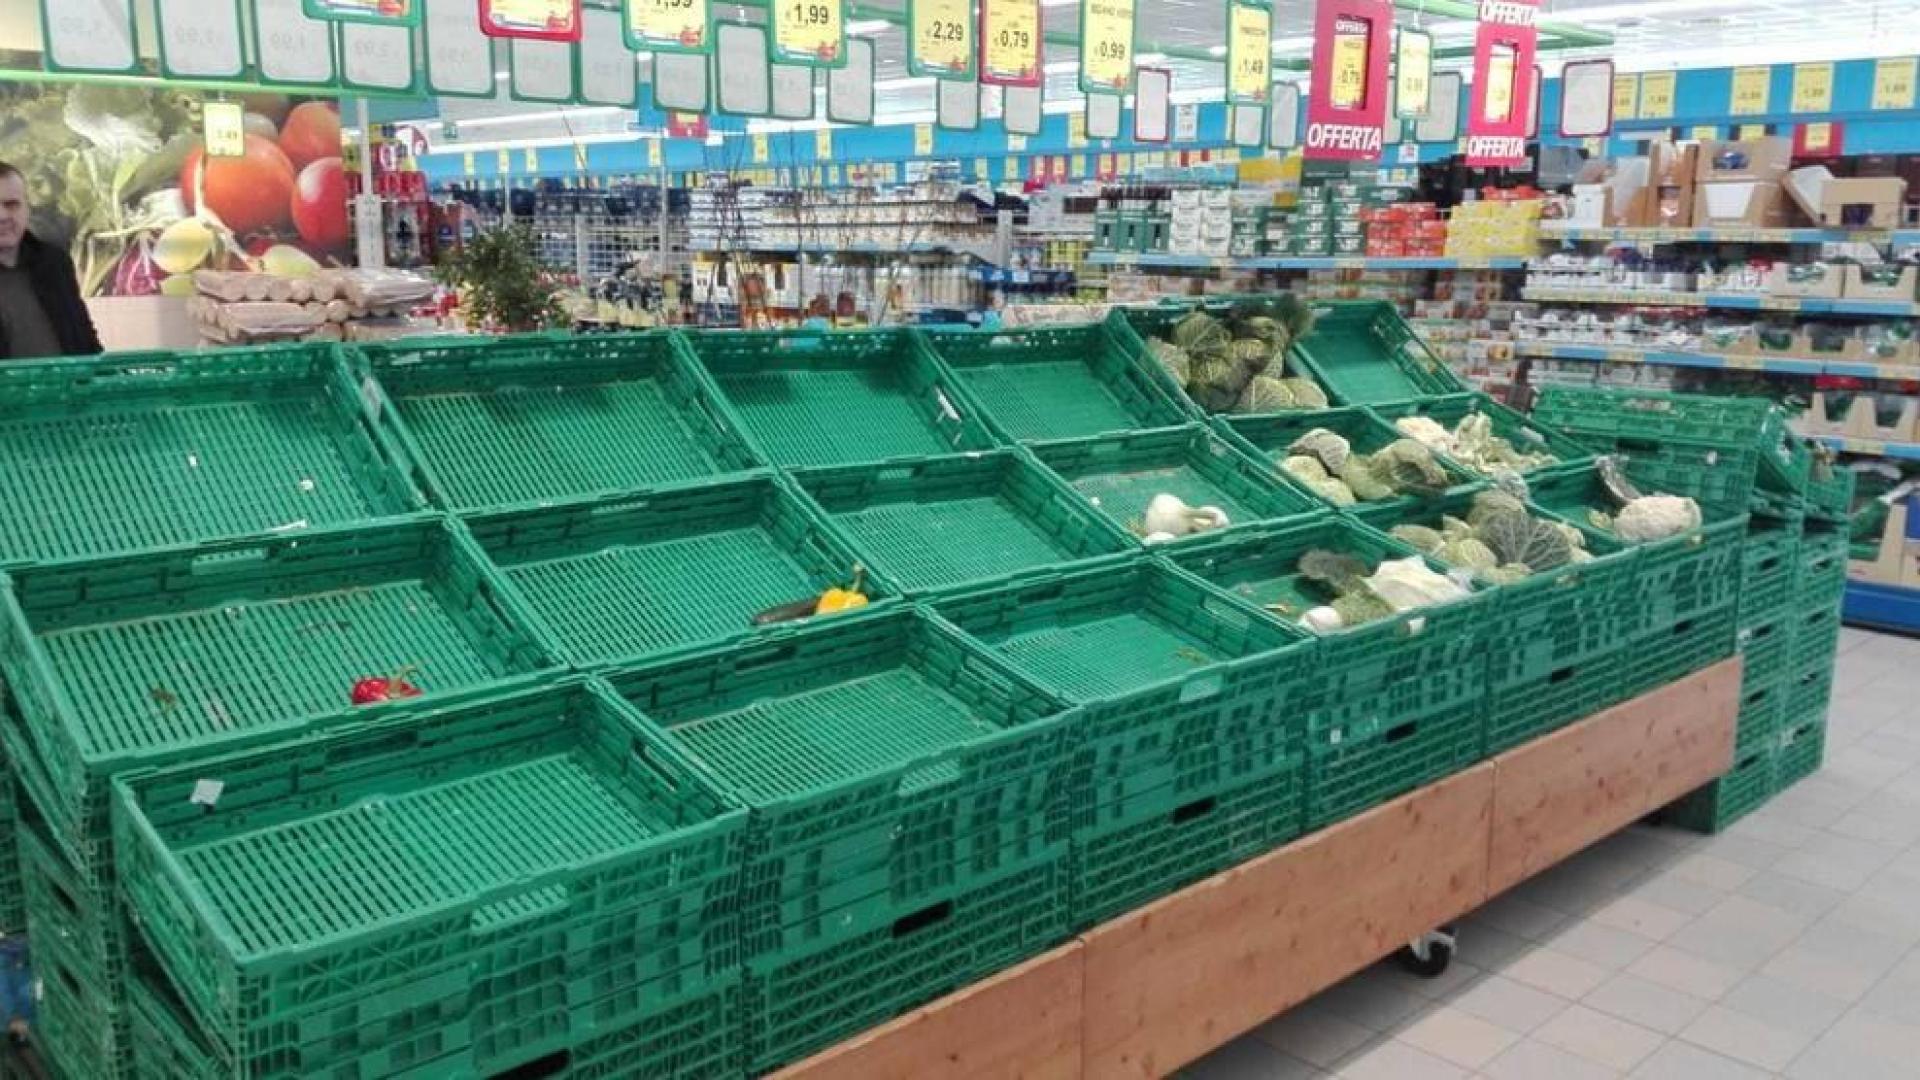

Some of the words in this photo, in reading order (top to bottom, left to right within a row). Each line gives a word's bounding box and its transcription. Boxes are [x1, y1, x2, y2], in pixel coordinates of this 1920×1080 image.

[794, 3, 829, 25] 1,99
[1479, 2, 1537, 26] OFFERTA
[932, 20, 964, 42] 2,29
[1000, 29, 1029, 49] 0,79
[1100, 40, 1126, 60] 0,99
[1307, 123, 1382, 151] OFFERTA
[1468, 136, 1525, 158] OFFERTA
